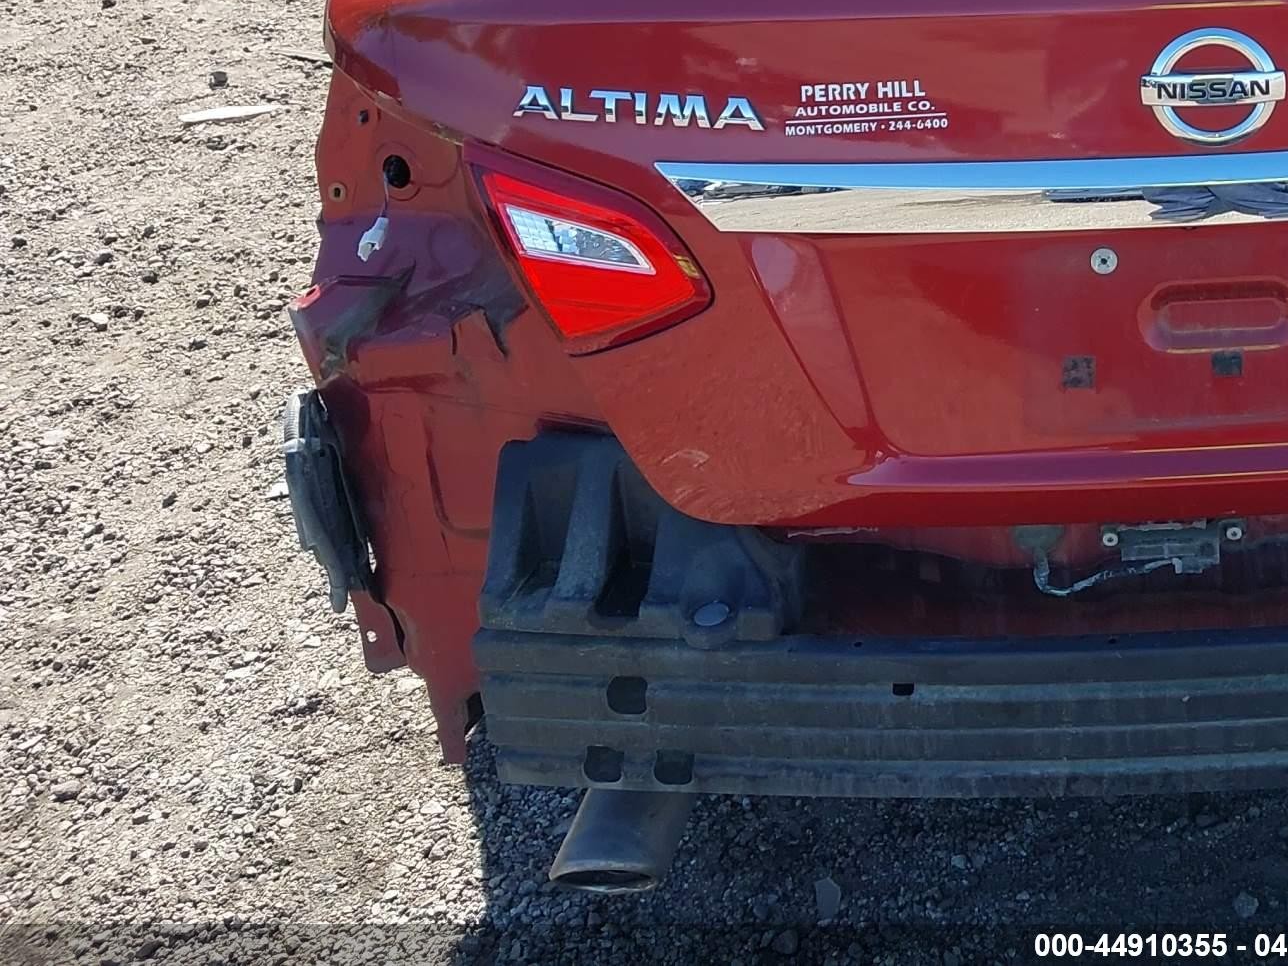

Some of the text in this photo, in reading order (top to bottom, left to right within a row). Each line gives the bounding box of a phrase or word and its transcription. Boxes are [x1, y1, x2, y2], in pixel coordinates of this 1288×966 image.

[800, 80, 926, 102] PERRY HILL
[1157, 79, 1270, 100] NISSAN
[513, 85, 765, 131] ALTIMA
[795, 100, 936, 118] AUTOMOBILE CO.
[784, 118, 949, 137] MONTGOMERY 244-6400
